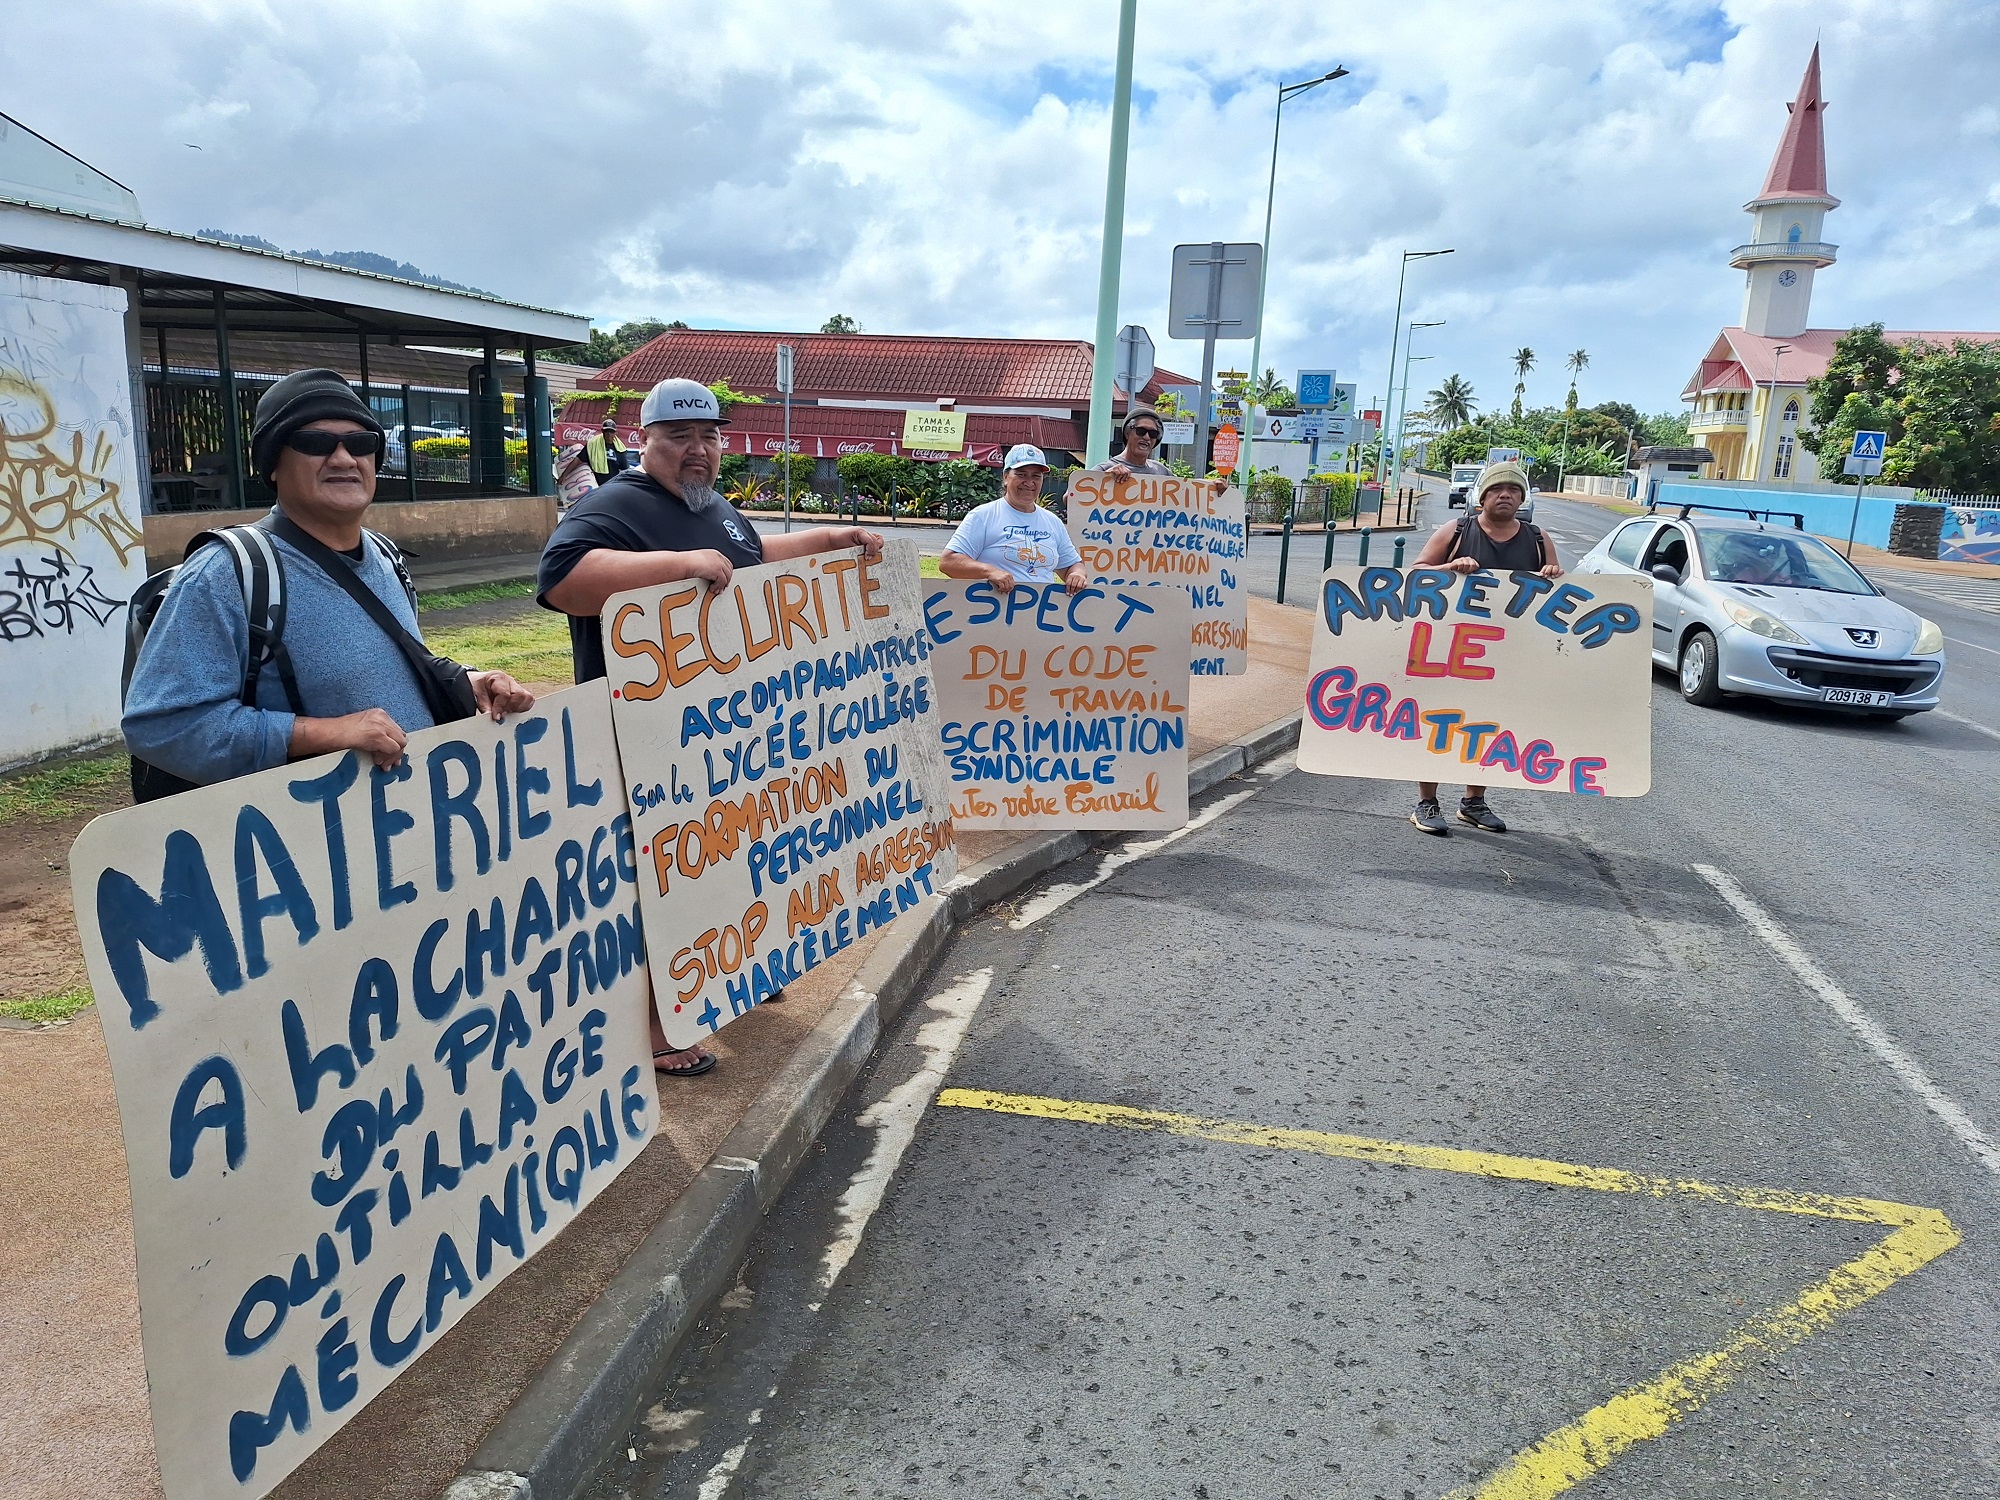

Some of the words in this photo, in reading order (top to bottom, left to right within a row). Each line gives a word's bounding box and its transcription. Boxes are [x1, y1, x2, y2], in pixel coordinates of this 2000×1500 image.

[912, 425, 956, 434] EXPRESS
[1081, 528, 1112, 545] SUR
[1221, 569, 1236, 590] DU
[923, 582, 1155, 647] ESPECT
[961, 645, 1027, 681] DU
[1043, 645, 1158, 679] CODE
[1405, 621, 1505, 680] LE
[984, 684, 1028, 711] DE
[1829, 690, 1872, 704] 209138
[1877, 694, 1886, 704] P
[1305, 665, 1607, 797] GRATTAGE
[864, 743, 898, 788] DU
[747, 779, 922, 898] PERSONNEL
[669, 901, 768, 1004] STOP
[787, 866, 845, 939] AUX
[169, 1053, 248, 1180] A
[412, 811, 637, 1022] CHARGE
[697, 996, 721, 1032] +
[312, 1064, 424, 1207] DU
[434, 900, 646, 1095] PATRON
